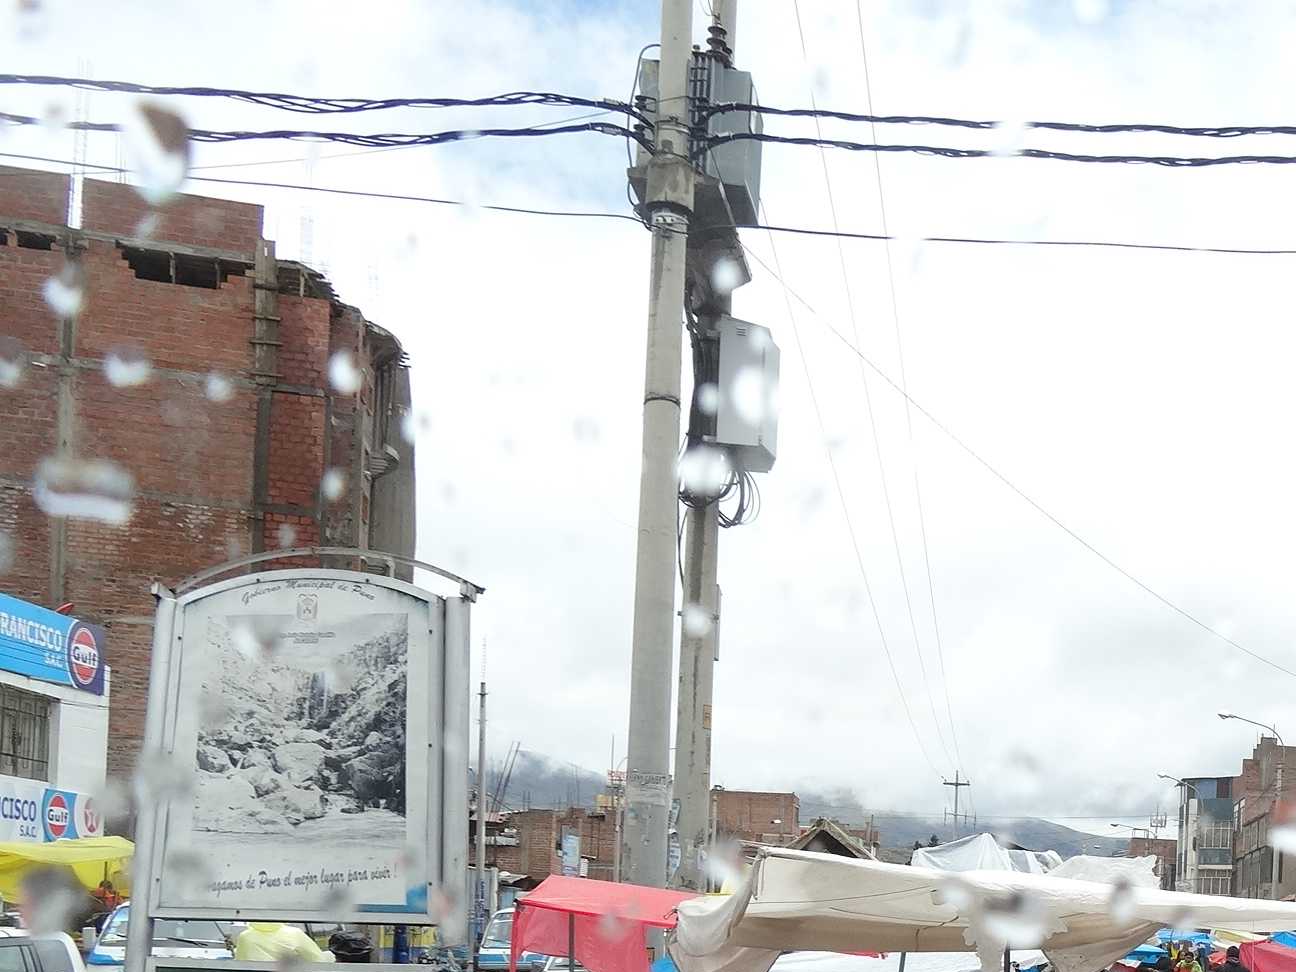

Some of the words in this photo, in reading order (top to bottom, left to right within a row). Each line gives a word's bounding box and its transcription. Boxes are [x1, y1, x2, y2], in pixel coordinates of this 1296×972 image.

[351, 584, 377, 600] Puno
[72, 646, 98, 667] Gulf
[47, 808, 69, 824] Gulf
[258, 870, 282, 889] Puno
[283, 870, 292, 887] el
[294, 871, 319, 892] mejor
[320, 867, 345, 889] lugar
[347, 867, 369, 887] para
